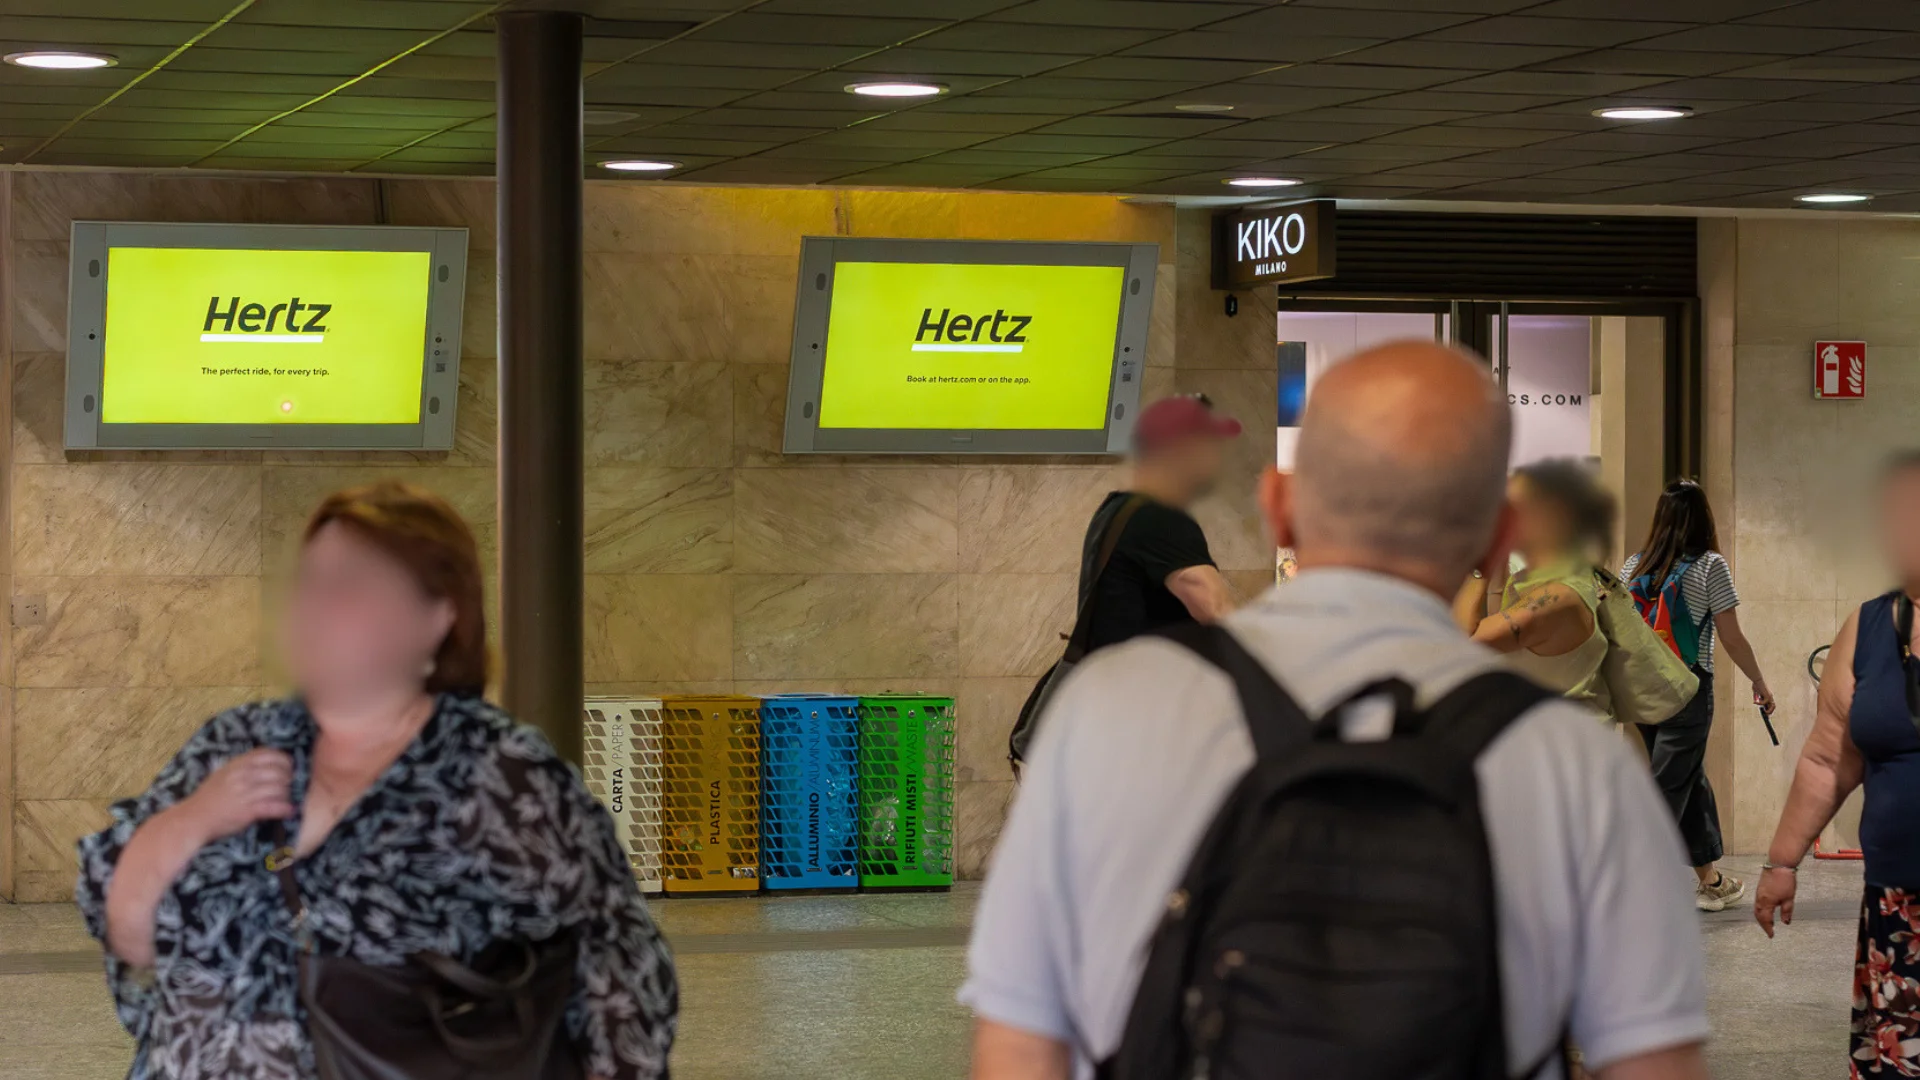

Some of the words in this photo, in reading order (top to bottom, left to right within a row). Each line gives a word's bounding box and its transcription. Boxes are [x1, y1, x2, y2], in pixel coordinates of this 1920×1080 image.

[1237, 213, 1305, 262] KIKO
[1255, 261, 1287, 276] MILANO
[203, 296, 332, 333] Hertz
[915, 308, 1033, 343] Hertz
[201, 367, 218, 376] The
[219, 367, 250, 377] perfect
[252, 367, 272, 377] ride,
[273, 367, 286, 376] for
[287, 369, 311, 377] every
[313, 367, 330, 377] trip.
[906, 375, 927, 383] Book
[938, 375, 977, 384] hertz.com
[1000, 376, 1013, 384] the
[1014, 377, 1031, 386] app.
[905, 816, 917, 864] RIFIUTI
